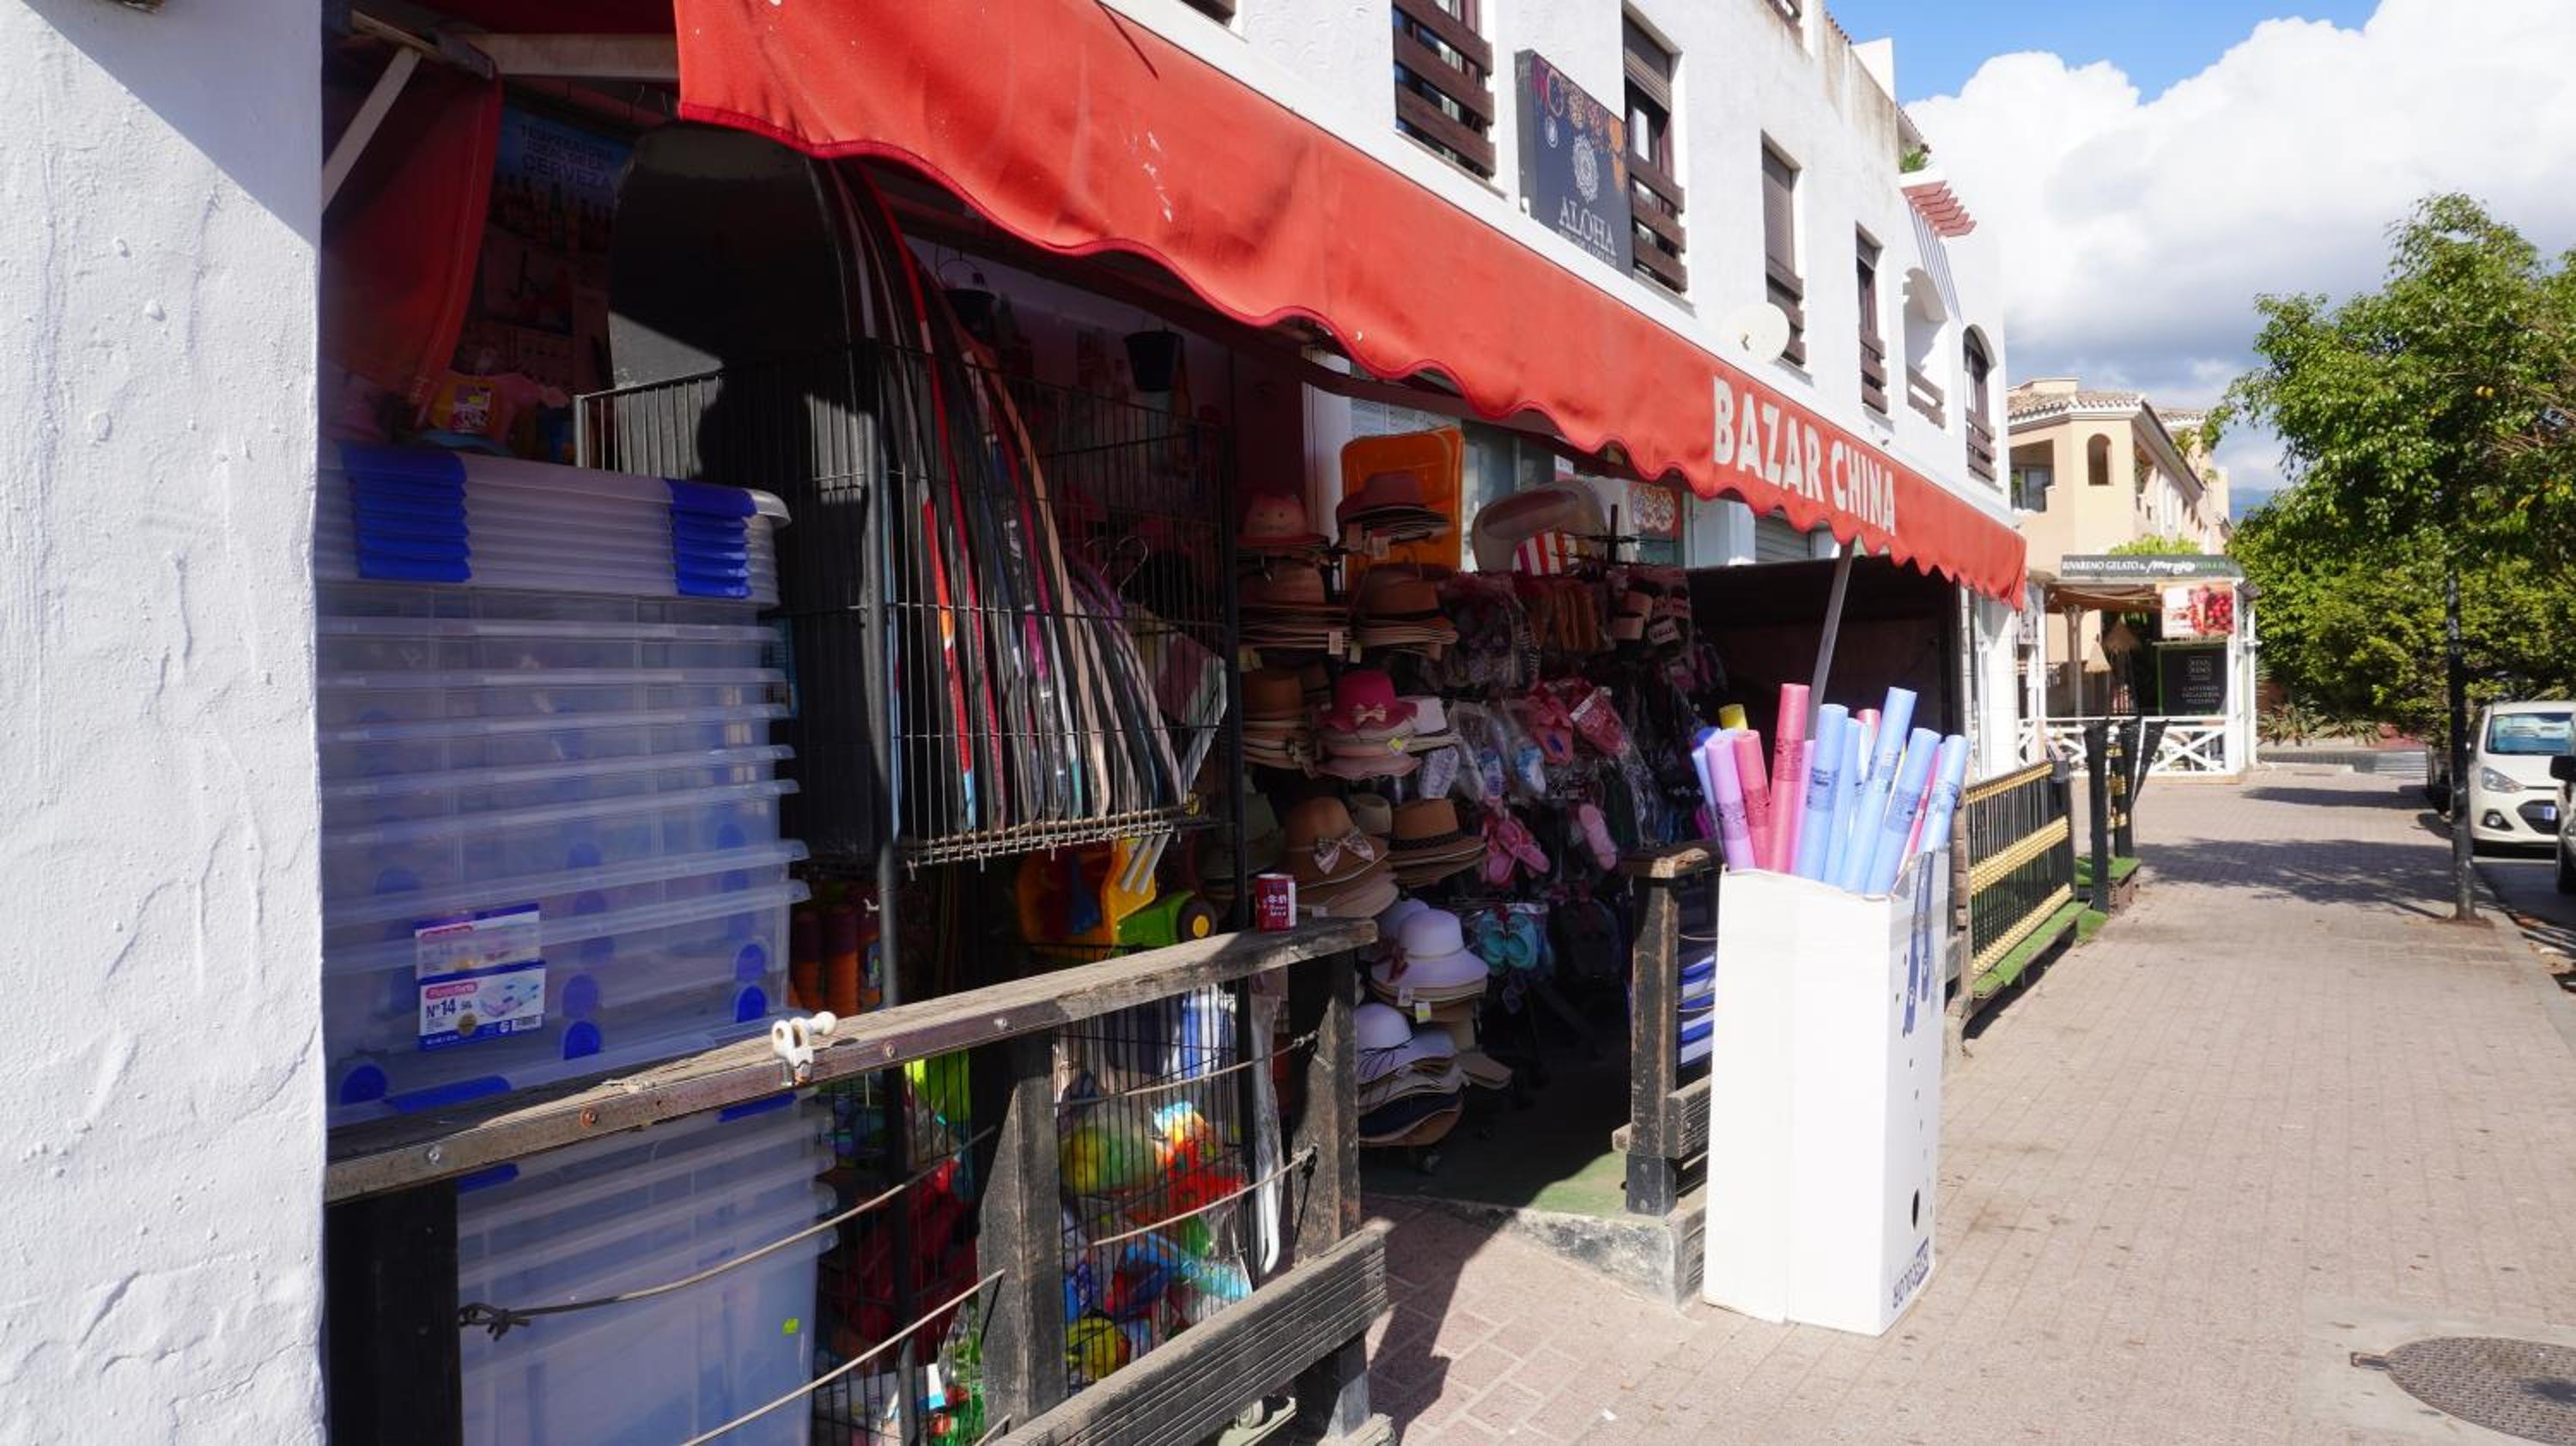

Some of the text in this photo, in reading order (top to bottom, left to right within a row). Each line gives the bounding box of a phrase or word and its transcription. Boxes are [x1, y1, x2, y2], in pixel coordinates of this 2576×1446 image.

[1558, 195, 1617, 257] ALOHA
[1713, 375, 1896, 537] BAZAR CHINA
[2105, 560, 2139, 571] GELATO
